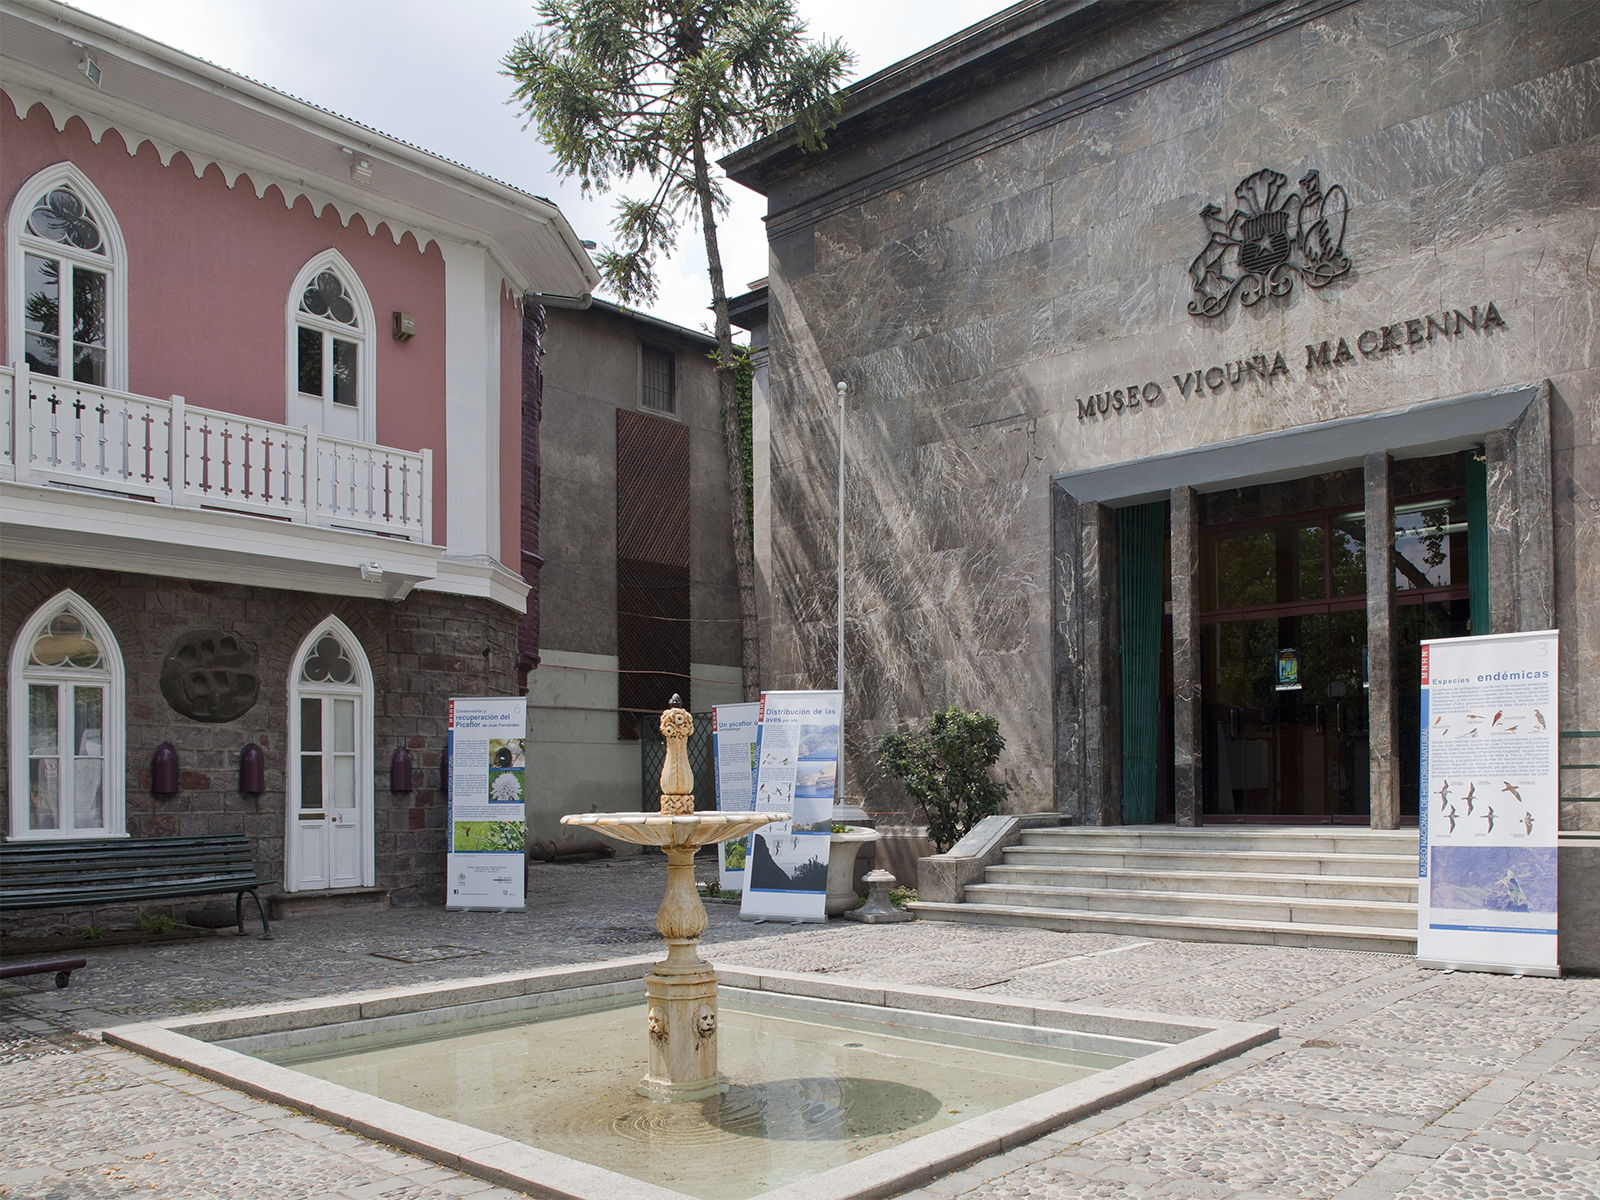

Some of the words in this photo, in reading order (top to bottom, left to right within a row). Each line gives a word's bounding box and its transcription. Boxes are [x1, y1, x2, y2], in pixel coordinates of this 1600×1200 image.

[1076, 382, 1161, 420] MUSEO
[1305, 301, 1505, 369] MACKENNA
[1537, 641, 1549, 658] 3
[1432, 677, 1470, 686] Especies
[1477, 670, 1549, 682] endémicas
[514, 704, 521, 714] 6
[766, 708, 810, 716] Distribución
[455, 713, 498, 721] recuperación
[728, 720, 752, 728] picaflor
[1421, 798, 1428, 808] DE
[1420, 809, 1428, 846] NACIONAL
